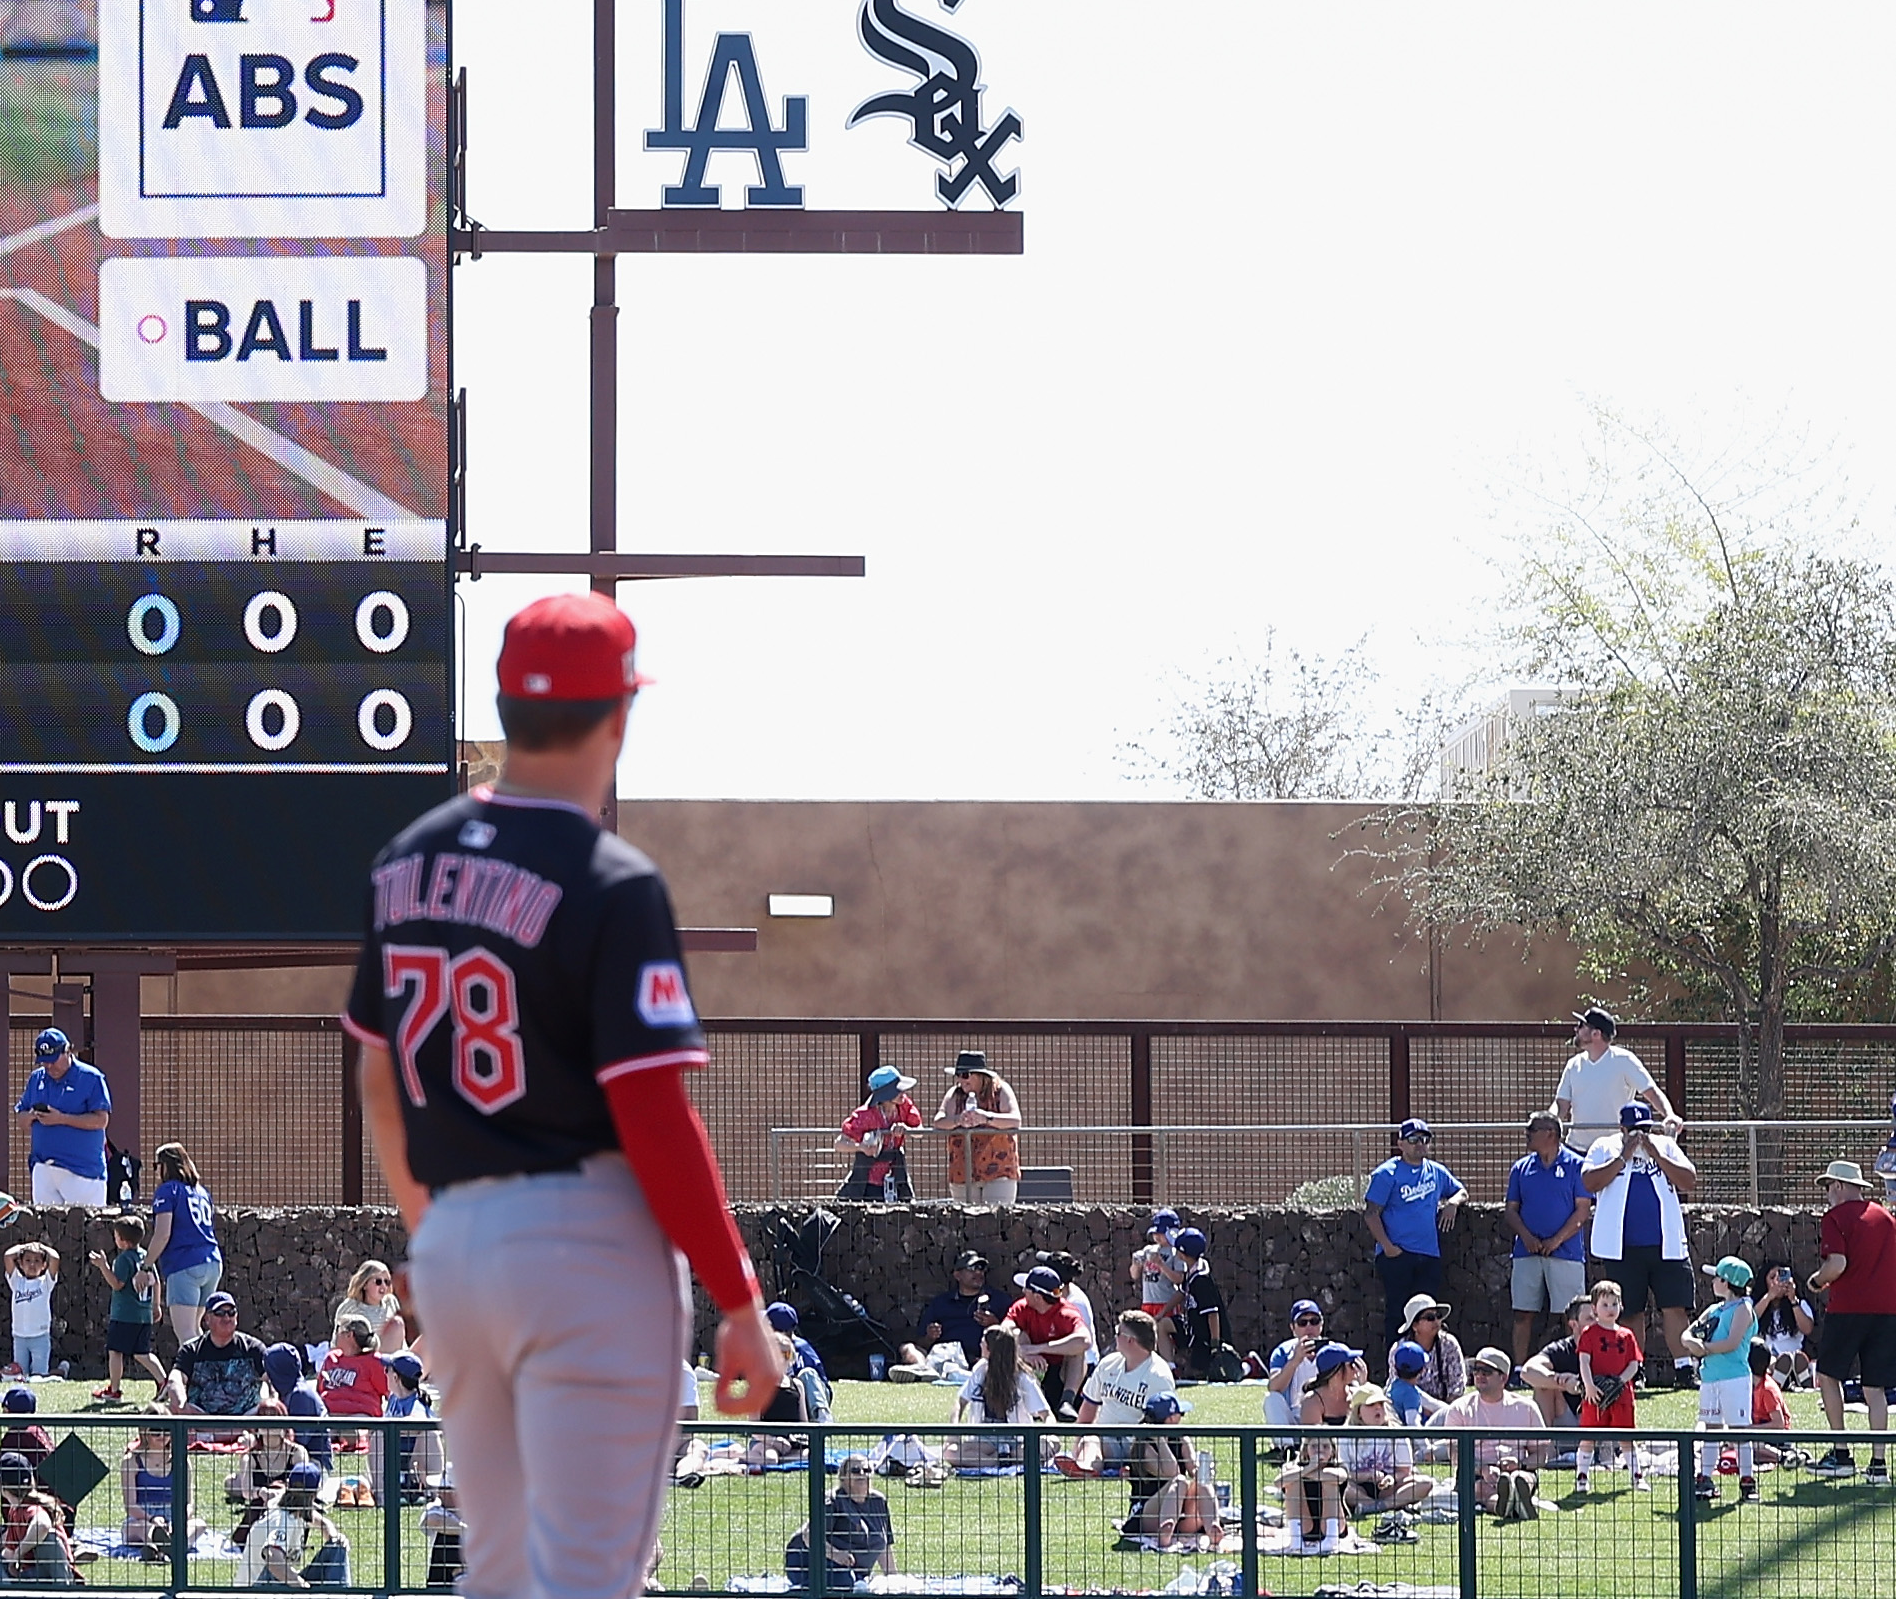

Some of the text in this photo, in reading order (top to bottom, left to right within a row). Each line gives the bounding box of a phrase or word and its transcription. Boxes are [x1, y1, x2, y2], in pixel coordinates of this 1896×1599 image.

[163, 53, 363, 130] ABS
[185, 300, 387, 361] BALL
[136, 529, 161, 557] R
[252, 529, 276, 557] H
[363, 529, 385, 557] E
[128, 595, 179, 654] 0
[245, 592, 296, 651] 0
[356, 592, 408, 652] 0
[129, 693, 180, 751] 0
[247, 690, 299, 749] 0
[359, 689, 411, 749] 0
[372, 852, 563, 948] TOLENTINO
[383, 943, 527, 1116] 78
[1400, 1180, 1437, 1202] Dodgers
[14, 1286, 43, 1303] Dodgers
